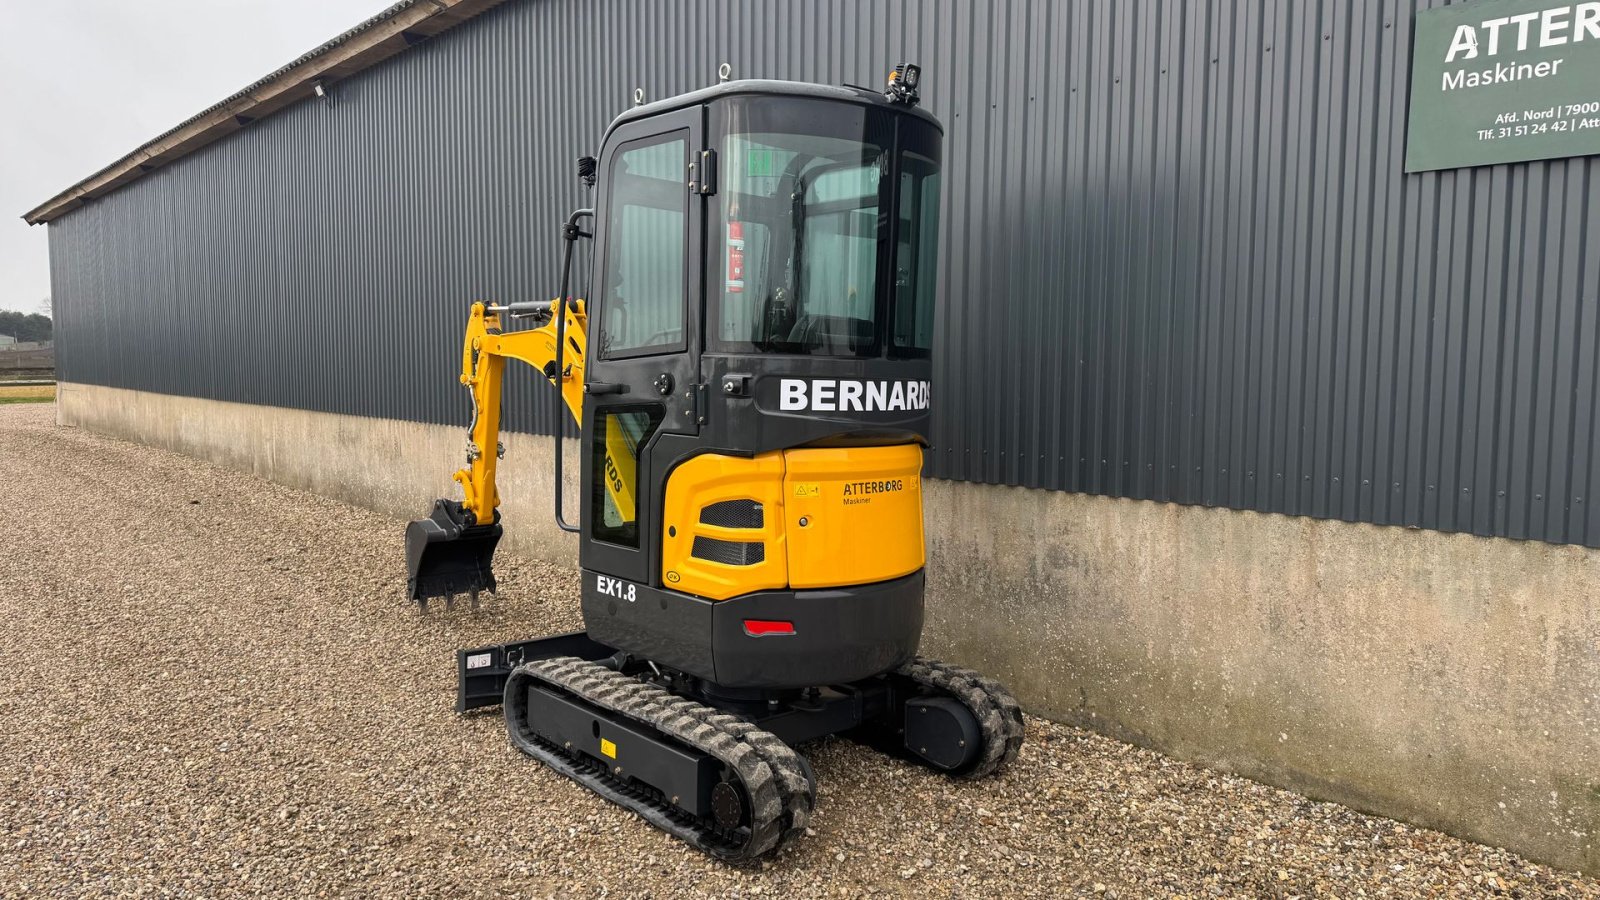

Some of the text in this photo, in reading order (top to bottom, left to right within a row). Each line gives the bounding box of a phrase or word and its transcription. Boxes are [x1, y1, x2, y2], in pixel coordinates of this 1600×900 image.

[1441, 58, 1564, 91] Maskiner
[1495, 113, 1520, 124] Afd.
[1523, 107, 1554, 121] Nord
[1565, 101, 1600, 116] 7900
[1477, 128, 1496, 141] Tlf.
[1498, 126, 1511, 138] 31
[1514, 125, 1528, 137] 51
[1531, 122, 1548, 134] 24
[1550, 120, 1568, 132] 42
[843, 479, 903, 496] ATTERBORG
[842, 496, 872, 506] Maskiner
[596, 576, 637, 602] EX1.8
